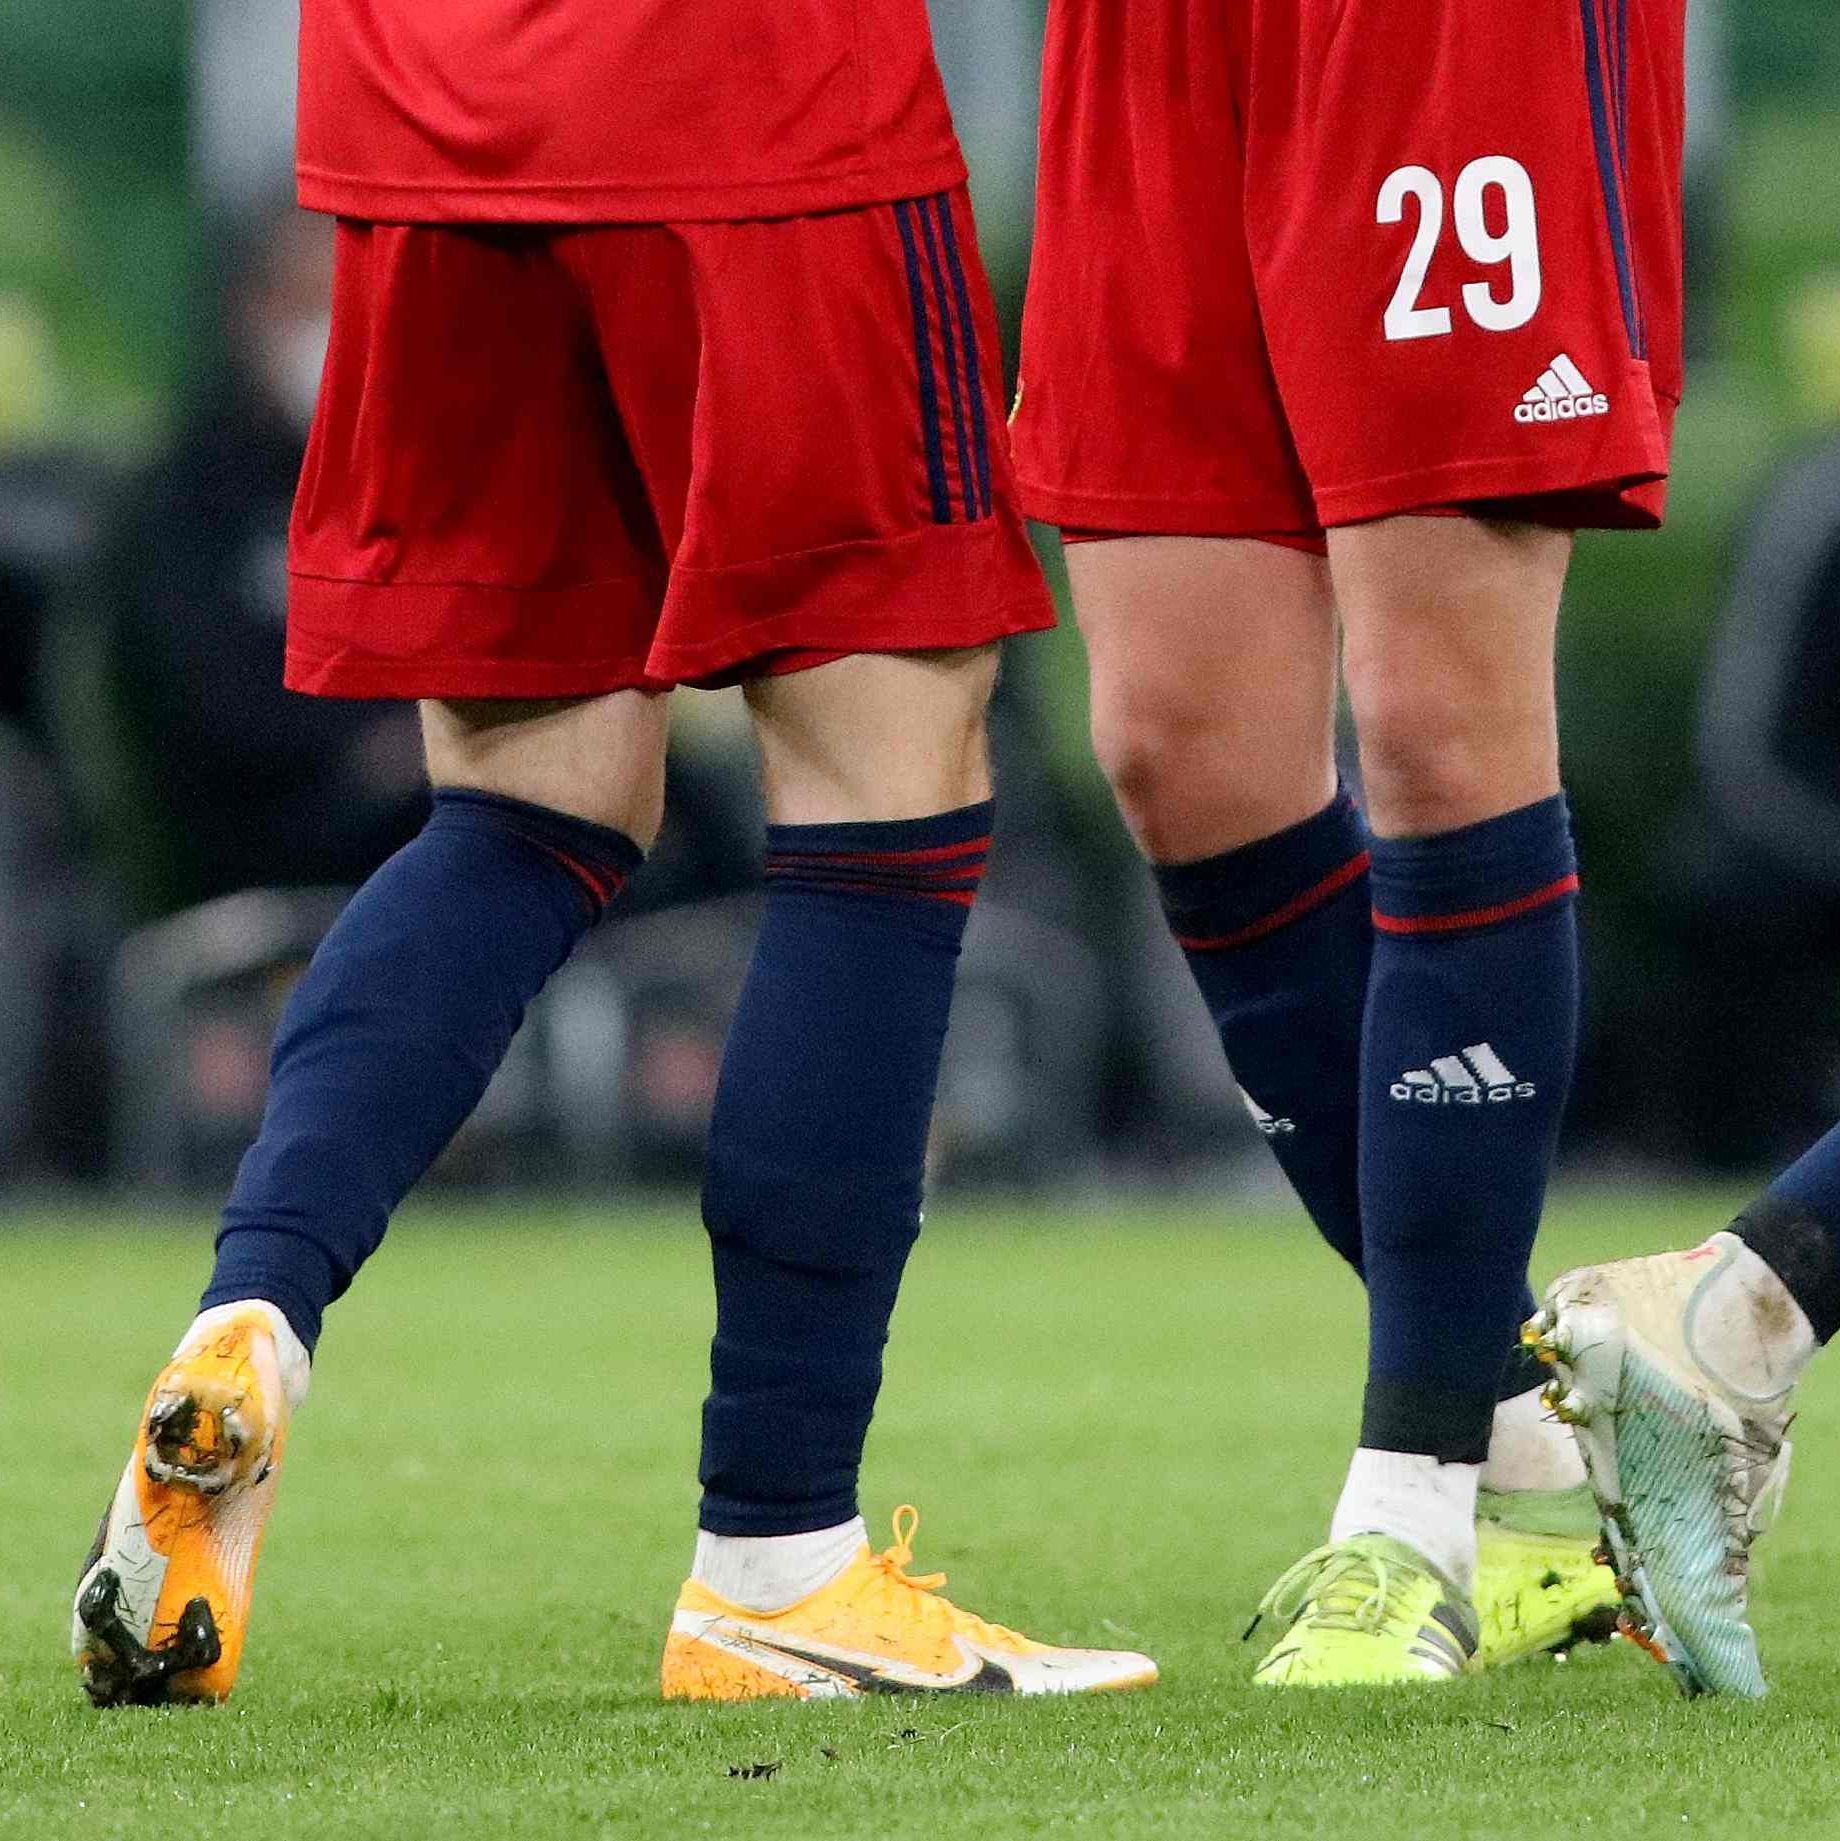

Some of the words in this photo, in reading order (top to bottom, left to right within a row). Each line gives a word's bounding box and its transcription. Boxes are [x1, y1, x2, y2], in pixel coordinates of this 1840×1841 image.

[1376, 154, 1542, 342] 29
[1514, 393, 1609, 422] adidas
[1390, 1080, 1537, 1104] adidas
